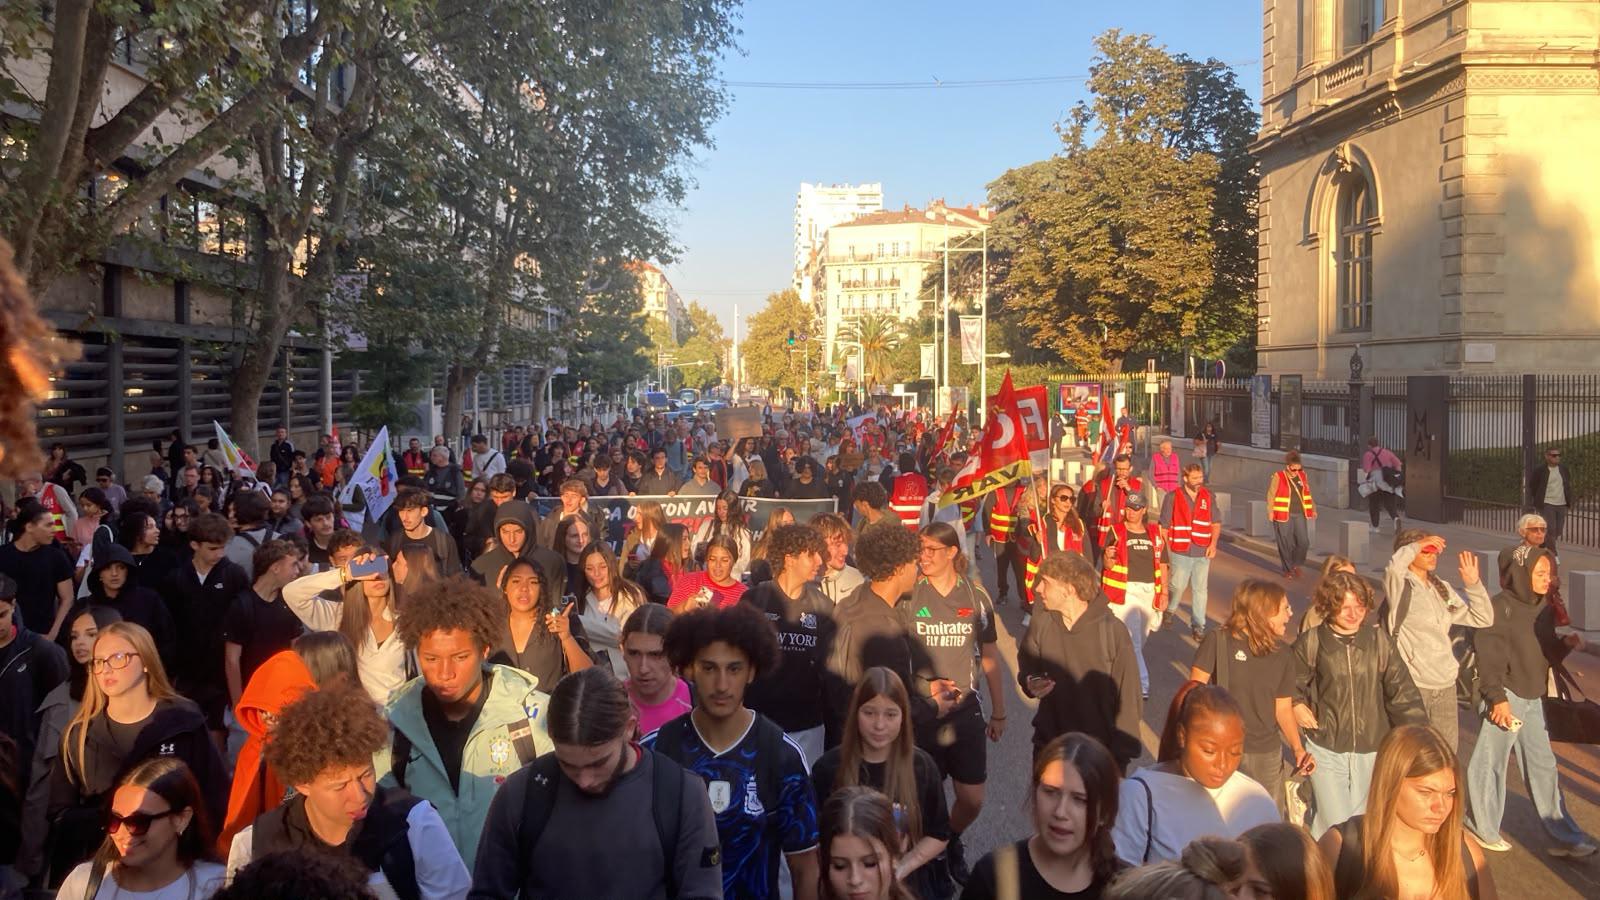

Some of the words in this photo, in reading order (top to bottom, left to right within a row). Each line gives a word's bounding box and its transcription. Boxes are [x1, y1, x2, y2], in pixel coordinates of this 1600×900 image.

[916, 621, 973, 635] Emirates
[926, 635, 938, 647] FLY
[940, 635, 966, 647] BETTER
